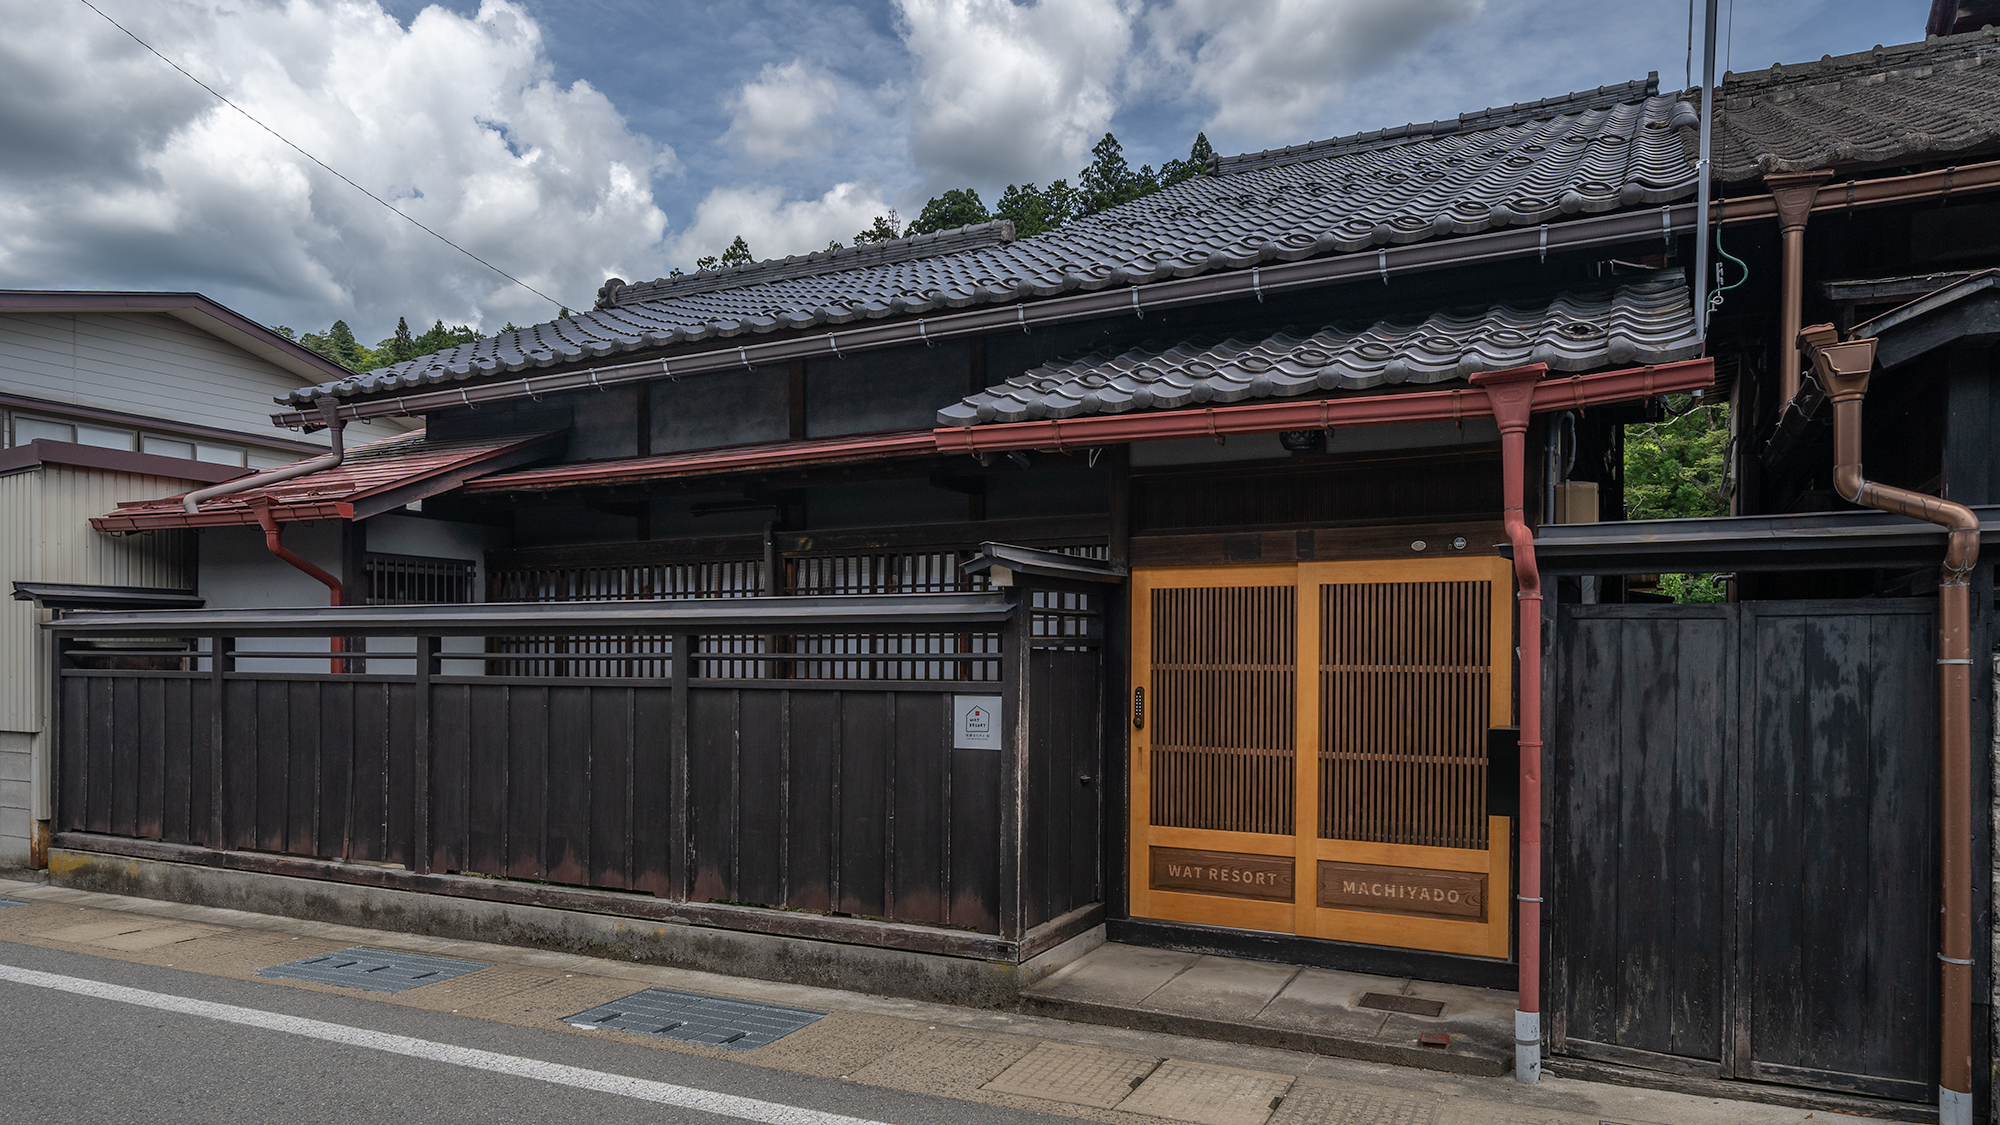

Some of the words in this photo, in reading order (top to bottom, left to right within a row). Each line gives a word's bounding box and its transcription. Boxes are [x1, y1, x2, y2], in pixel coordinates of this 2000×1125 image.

[1168, 864, 1203, 879] WAT
[1209, 868, 1278, 886] RESORT
[1342, 880, 1460, 904] MACHIYADO
